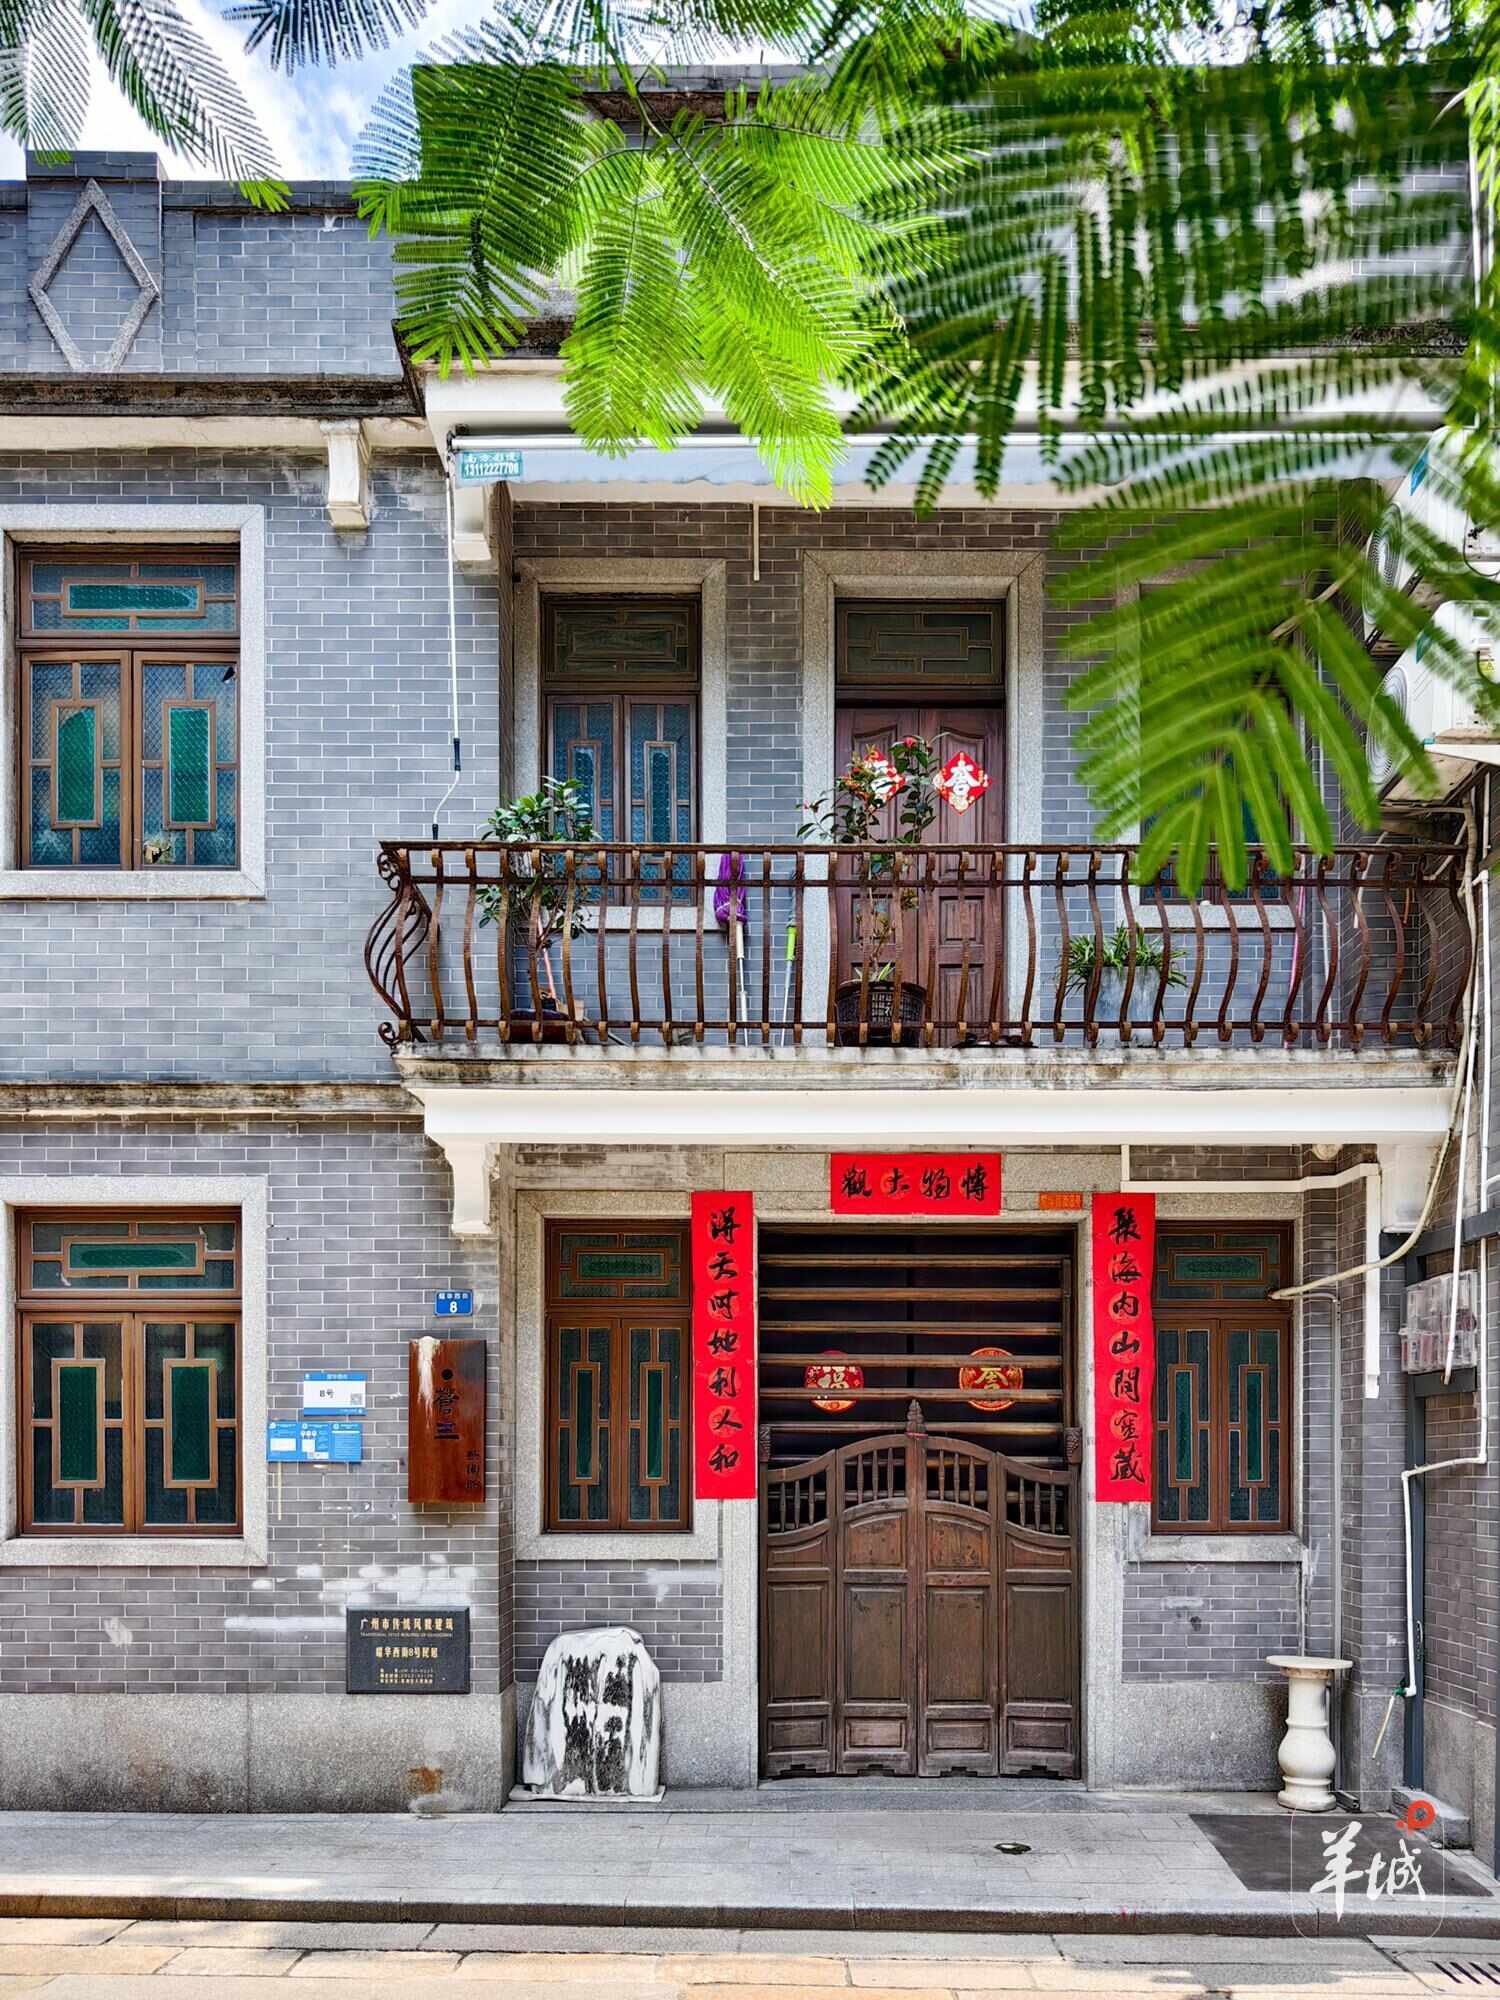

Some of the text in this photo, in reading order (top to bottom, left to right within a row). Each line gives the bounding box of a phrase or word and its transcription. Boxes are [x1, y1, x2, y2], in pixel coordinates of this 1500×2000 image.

[449, 1301, 458, 1313] 8
[319, 1389, 334, 1398] 8号
[360, 1617, 454, 1631] 广州市传统风貌建筑
